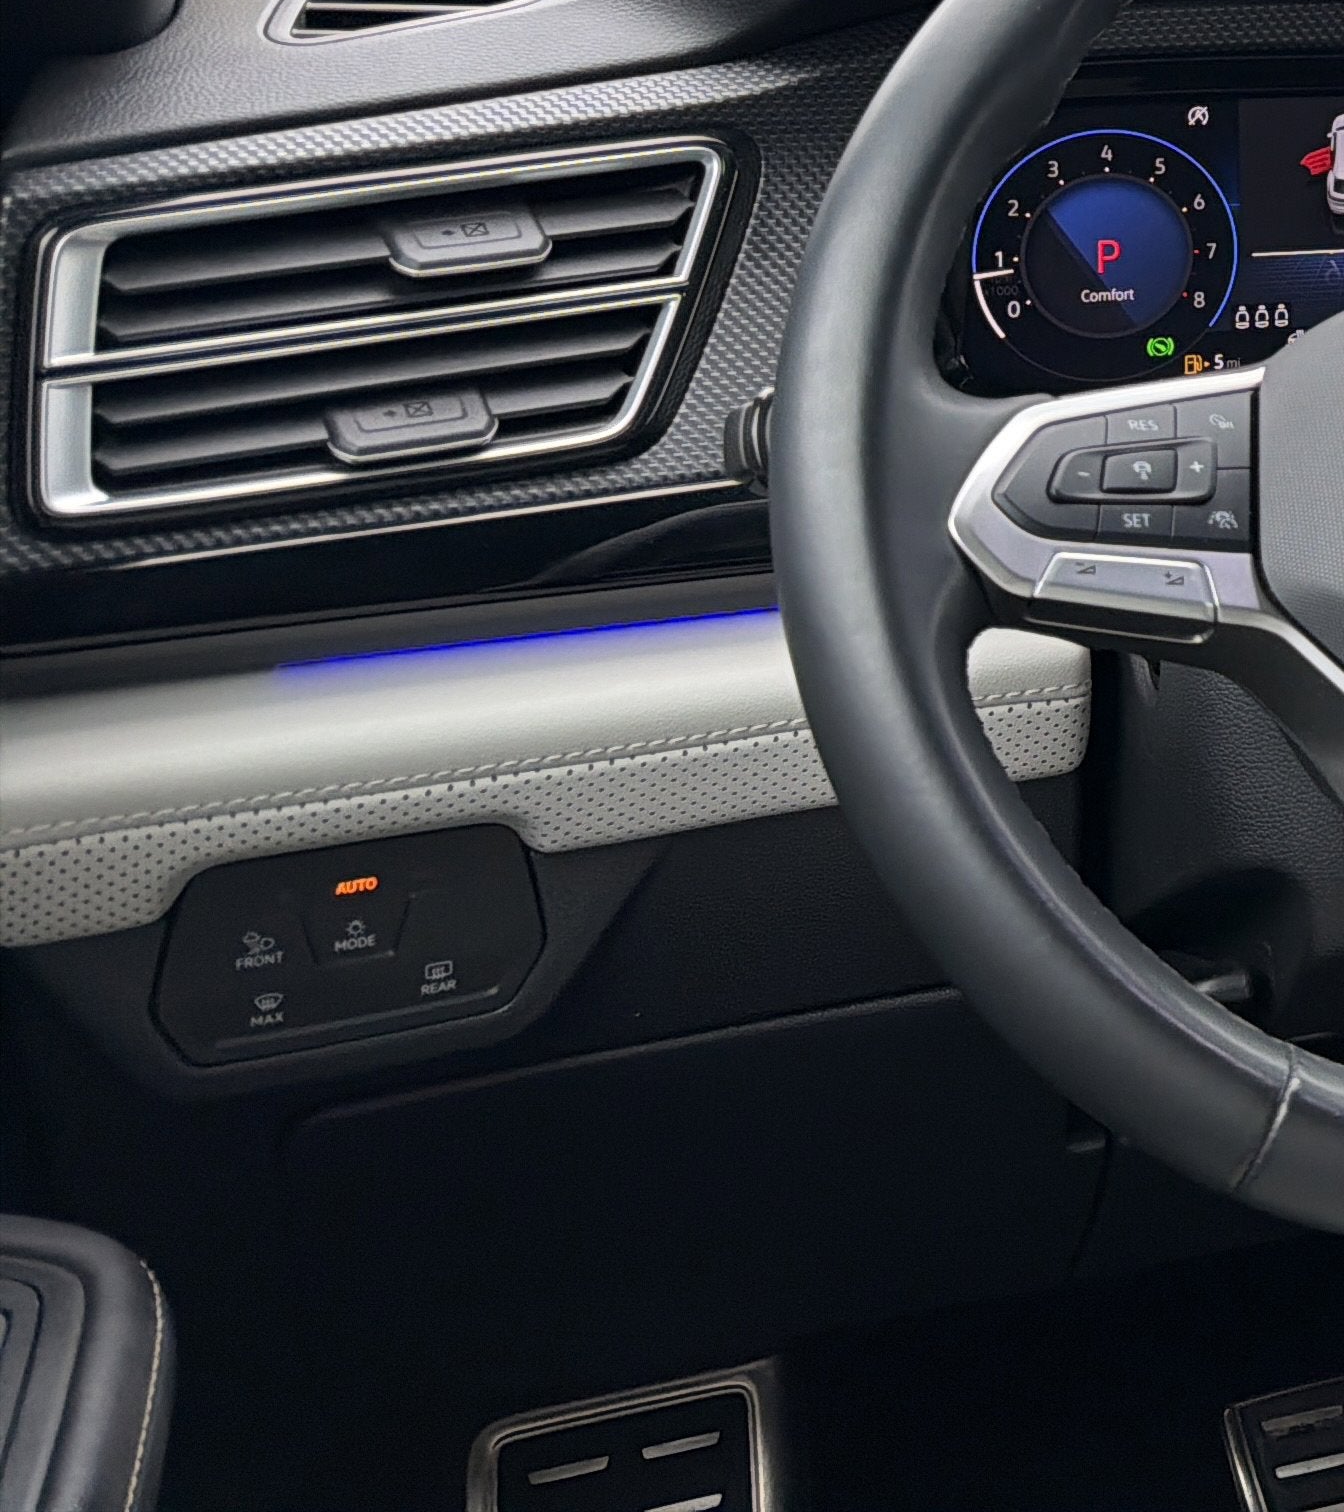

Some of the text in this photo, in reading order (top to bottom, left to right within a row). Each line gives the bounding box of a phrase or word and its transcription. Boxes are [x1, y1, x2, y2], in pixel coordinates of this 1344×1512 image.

[1100, 144, 1113, 162] 4
[1047, 160, 1059, 178] 3
[1154, 158, 1166, 175] 5
[1007, 199, 1019, 217] 2
[1193, 194, 1206, 210] 6
[1097, 239, 1121, 274] P
[1206, 242, 1217, 259] 7
[994, 251, 1003, 268] 1
[1080, 288, 1135, 303] Comfort
[1193, 291, 1206, 308] 8
[1007, 301, 1021, 319] 0
[1213, 354, 1241, 370] 5 mi
[1127, 418, 1159, 432] RES
[1122, 513, 1151, 528] SET
[334, 875, 379, 897] AUTO
[334, 934, 377, 953] MODE
[235, 950, 284, 971] FRONT
[421, 979, 457, 996] REAR
[250, 1011, 284, 1028] MAX
